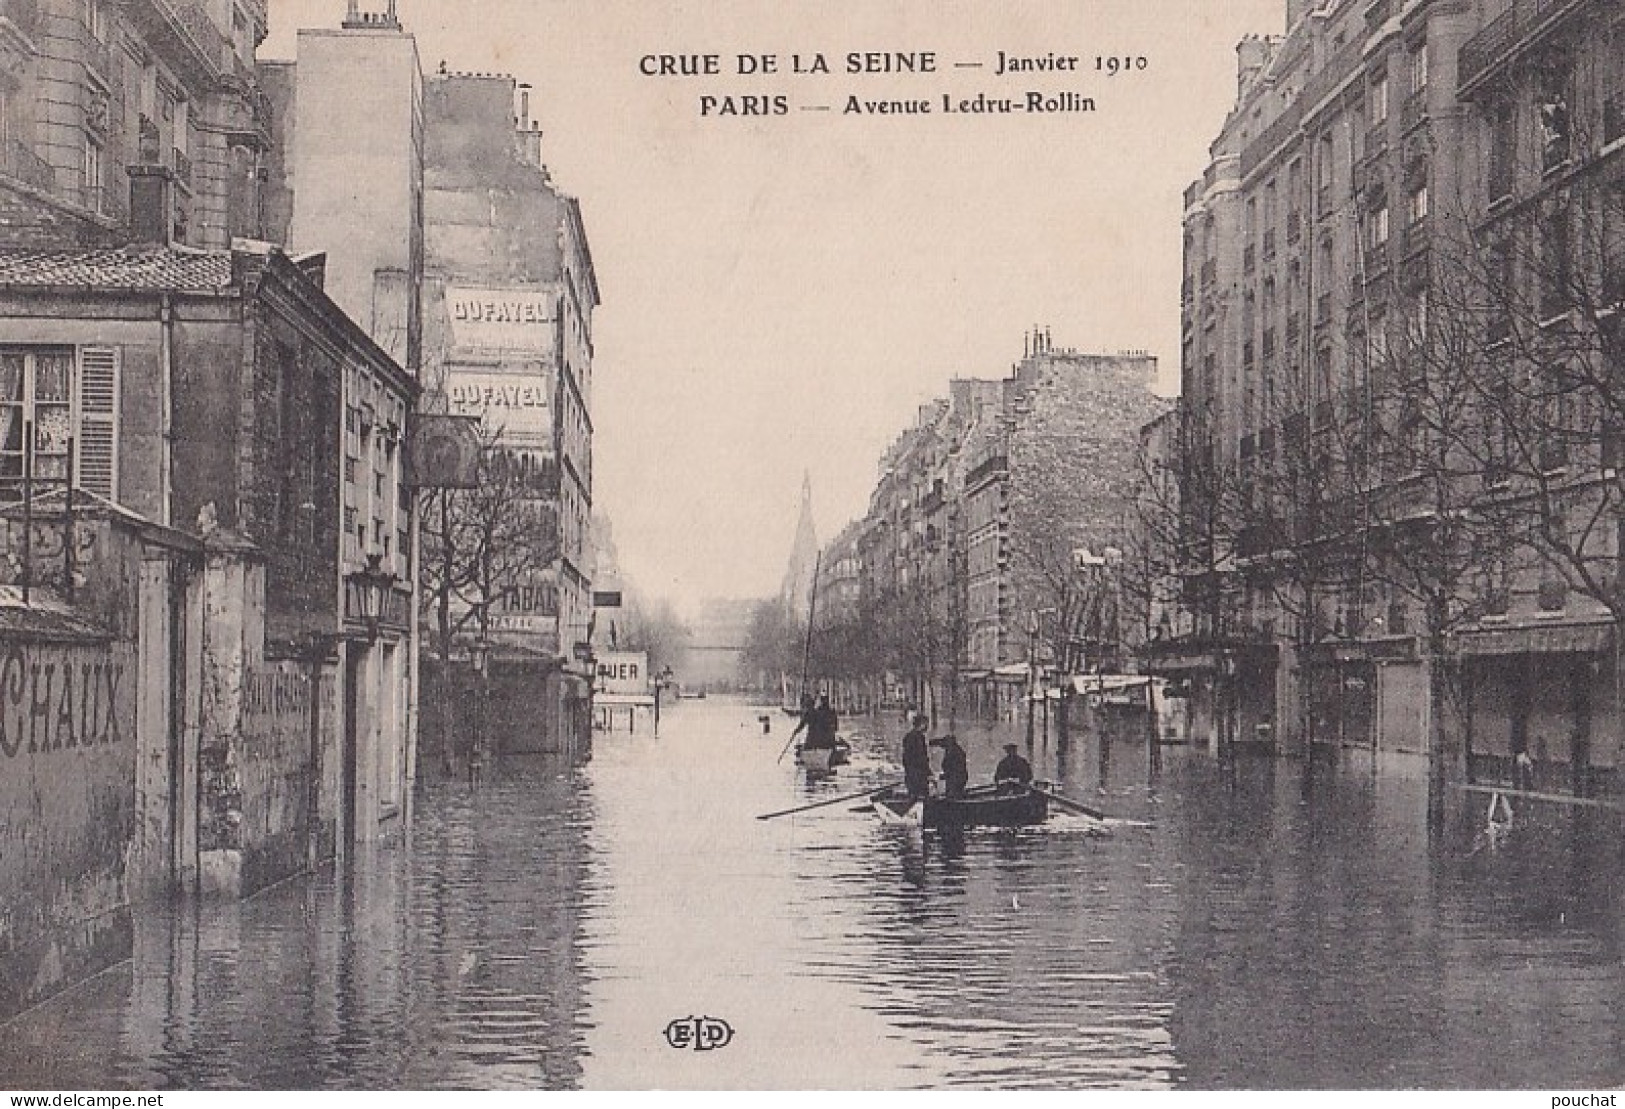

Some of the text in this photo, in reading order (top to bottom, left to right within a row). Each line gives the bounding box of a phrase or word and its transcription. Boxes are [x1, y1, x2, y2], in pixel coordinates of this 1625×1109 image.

[454, 300, 549, 324] DUFAYEL
[452, 384, 548, 408] DUFAYEL
[0, 647, 123, 758] CHAUX
